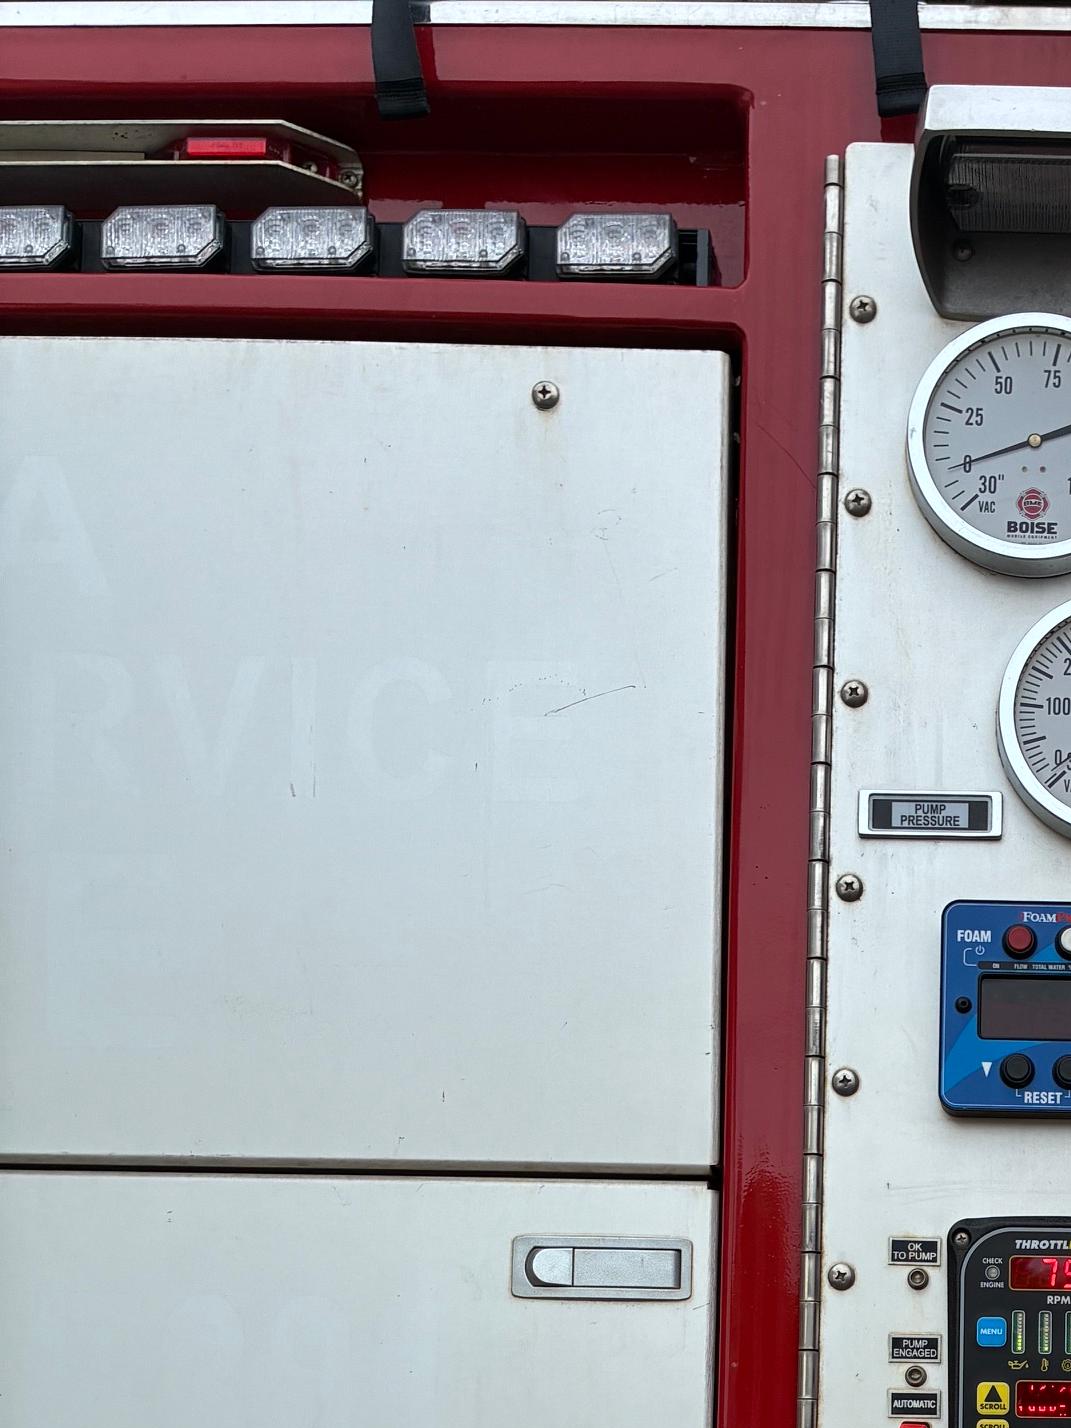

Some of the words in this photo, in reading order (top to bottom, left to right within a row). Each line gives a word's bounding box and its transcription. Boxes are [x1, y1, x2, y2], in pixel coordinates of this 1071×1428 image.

[1044, 370, 1061, 388] 75
[994, 377, 1013, 395] 50
[965, 408, 983, 426] 25
[963, 455, 972, 473] 0
[978, 501, 996, 513] VAC
[1007, 521, 1058, 534] BOISE
[1046, 698, 1071, 715] 100
[914, 804, 946, 815] PUMP
[900, 814, 960, 827] PRESSURE
[957, 930, 991, 942] FOAM
[1024, 1092, 1062, 1103] RESET
[908, 1242, 922, 1251] OK
[893, 1251, 906, 1260] TO
[908, 1252, 936, 1260] PUMP
[1047, 1296, 1071, 1304] RPM
[903, 1340, 928, 1348] PUMP
[894, 1348, 936, 1357] ENGAGED
[893, 1400, 936, 1408] AUTOMATIC
